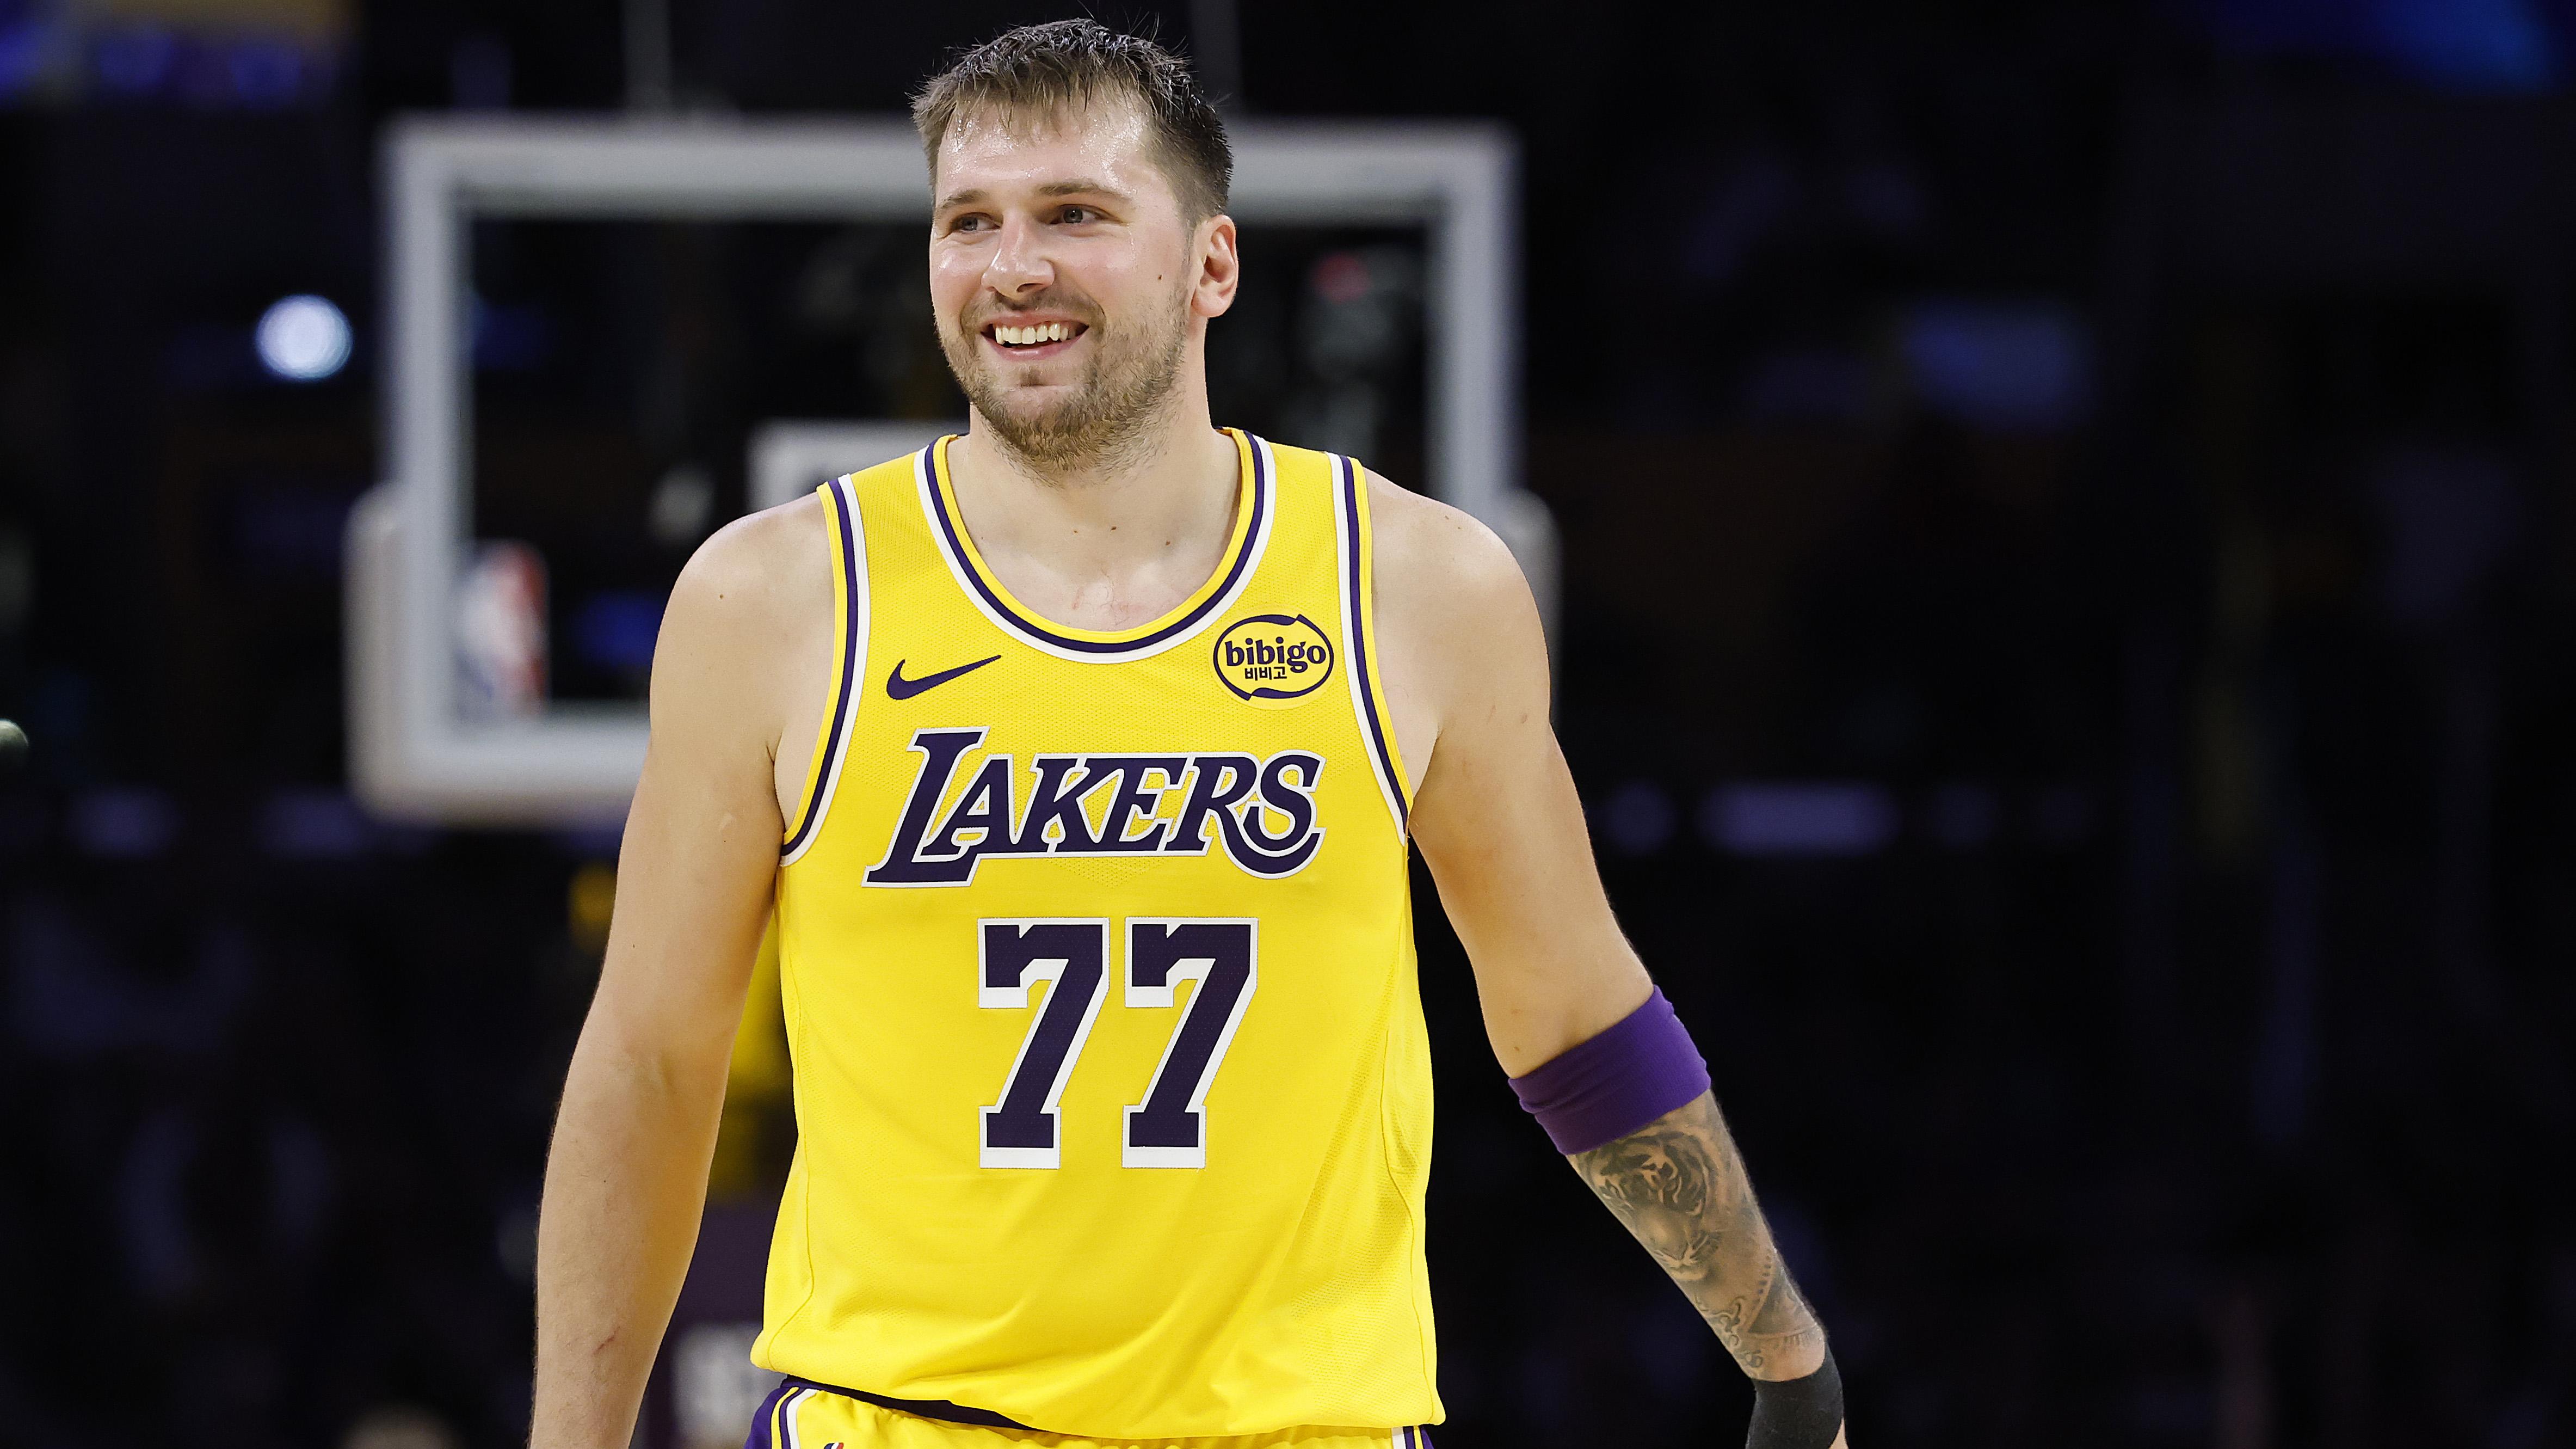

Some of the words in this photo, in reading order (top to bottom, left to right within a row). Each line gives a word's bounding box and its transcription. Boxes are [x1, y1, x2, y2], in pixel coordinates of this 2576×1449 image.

[1224, 636, 1327, 673] bibigo
[1244, 666, 1287, 681] 비비고
[861, 726, 1327, 888] LAKERS
[977, 916, 1259, 1169] 77
